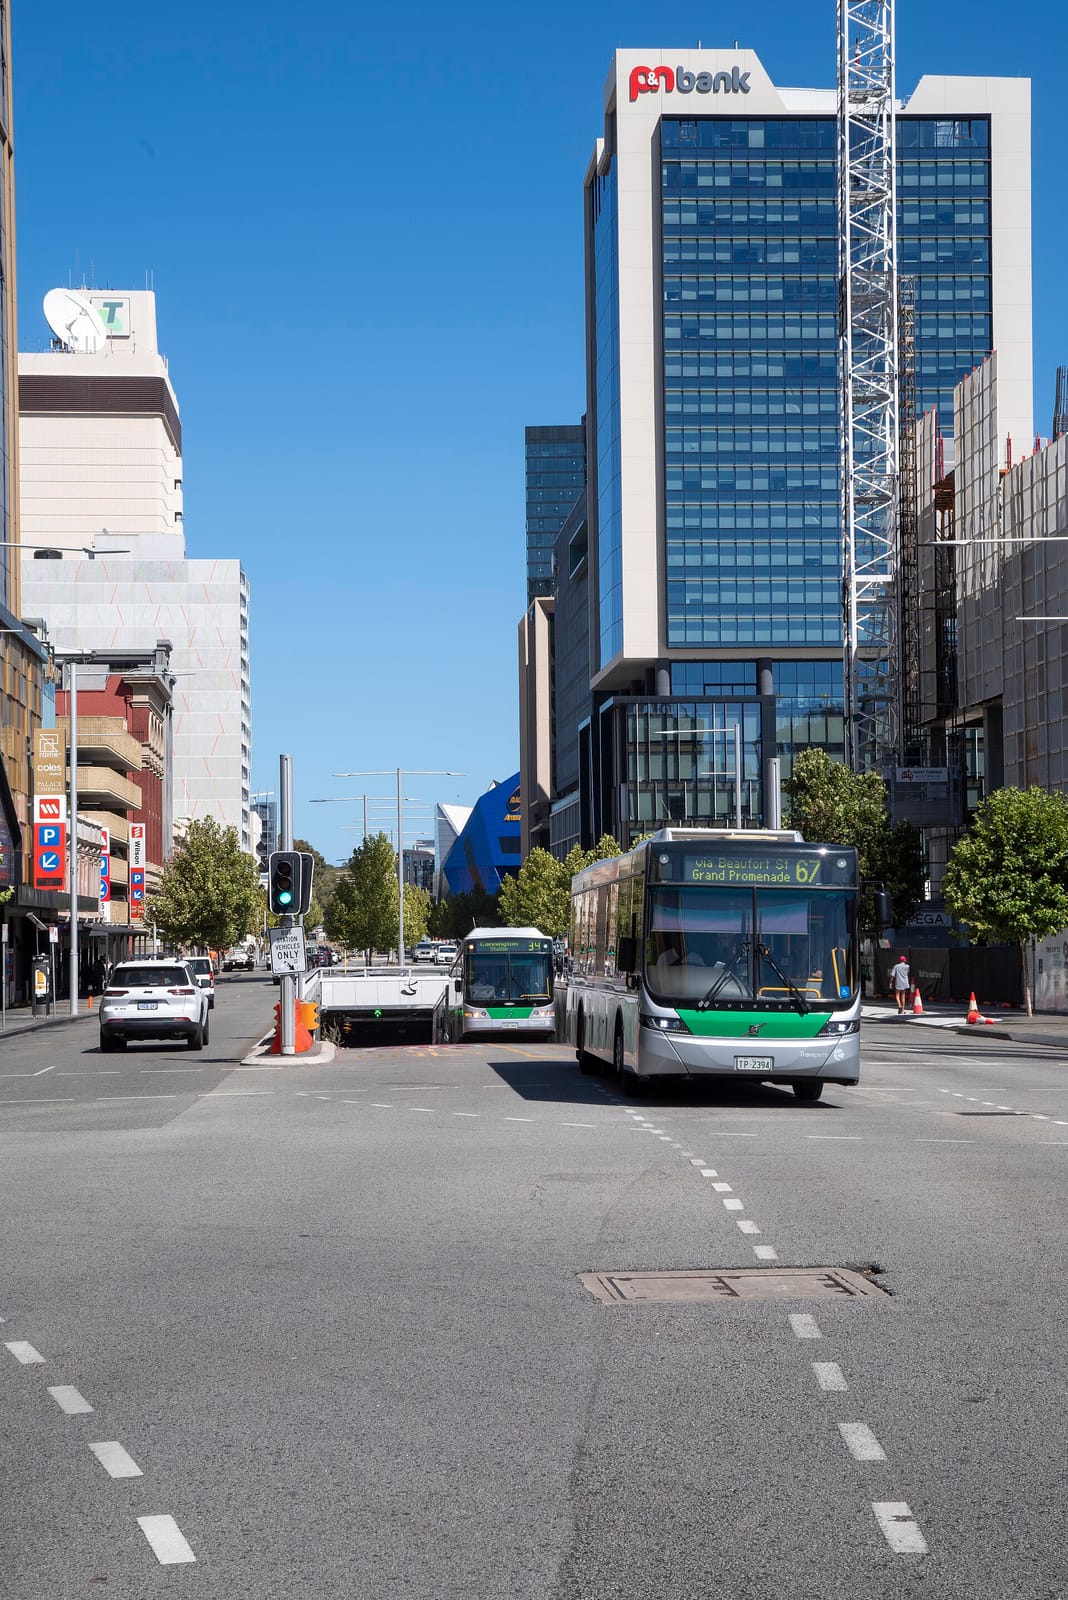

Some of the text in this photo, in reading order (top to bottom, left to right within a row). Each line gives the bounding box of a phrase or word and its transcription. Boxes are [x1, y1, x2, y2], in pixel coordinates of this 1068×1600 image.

[676, 65, 751, 94] bank
[103, 302, 123, 323] T
[37, 763, 62, 772] coles
[44, 829, 56, 844] P
[718, 857, 770, 869] Beaufort
[775, 858, 789, 870] St
[692, 869, 791, 882] Grand Promenade
[796, 859, 821, 883] 67
[134, 874, 141, 883] P
[274, 942, 300, 951] VEHICLES
[528, 941, 540, 951] 34
[277, 949, 299, 960] ONLY
